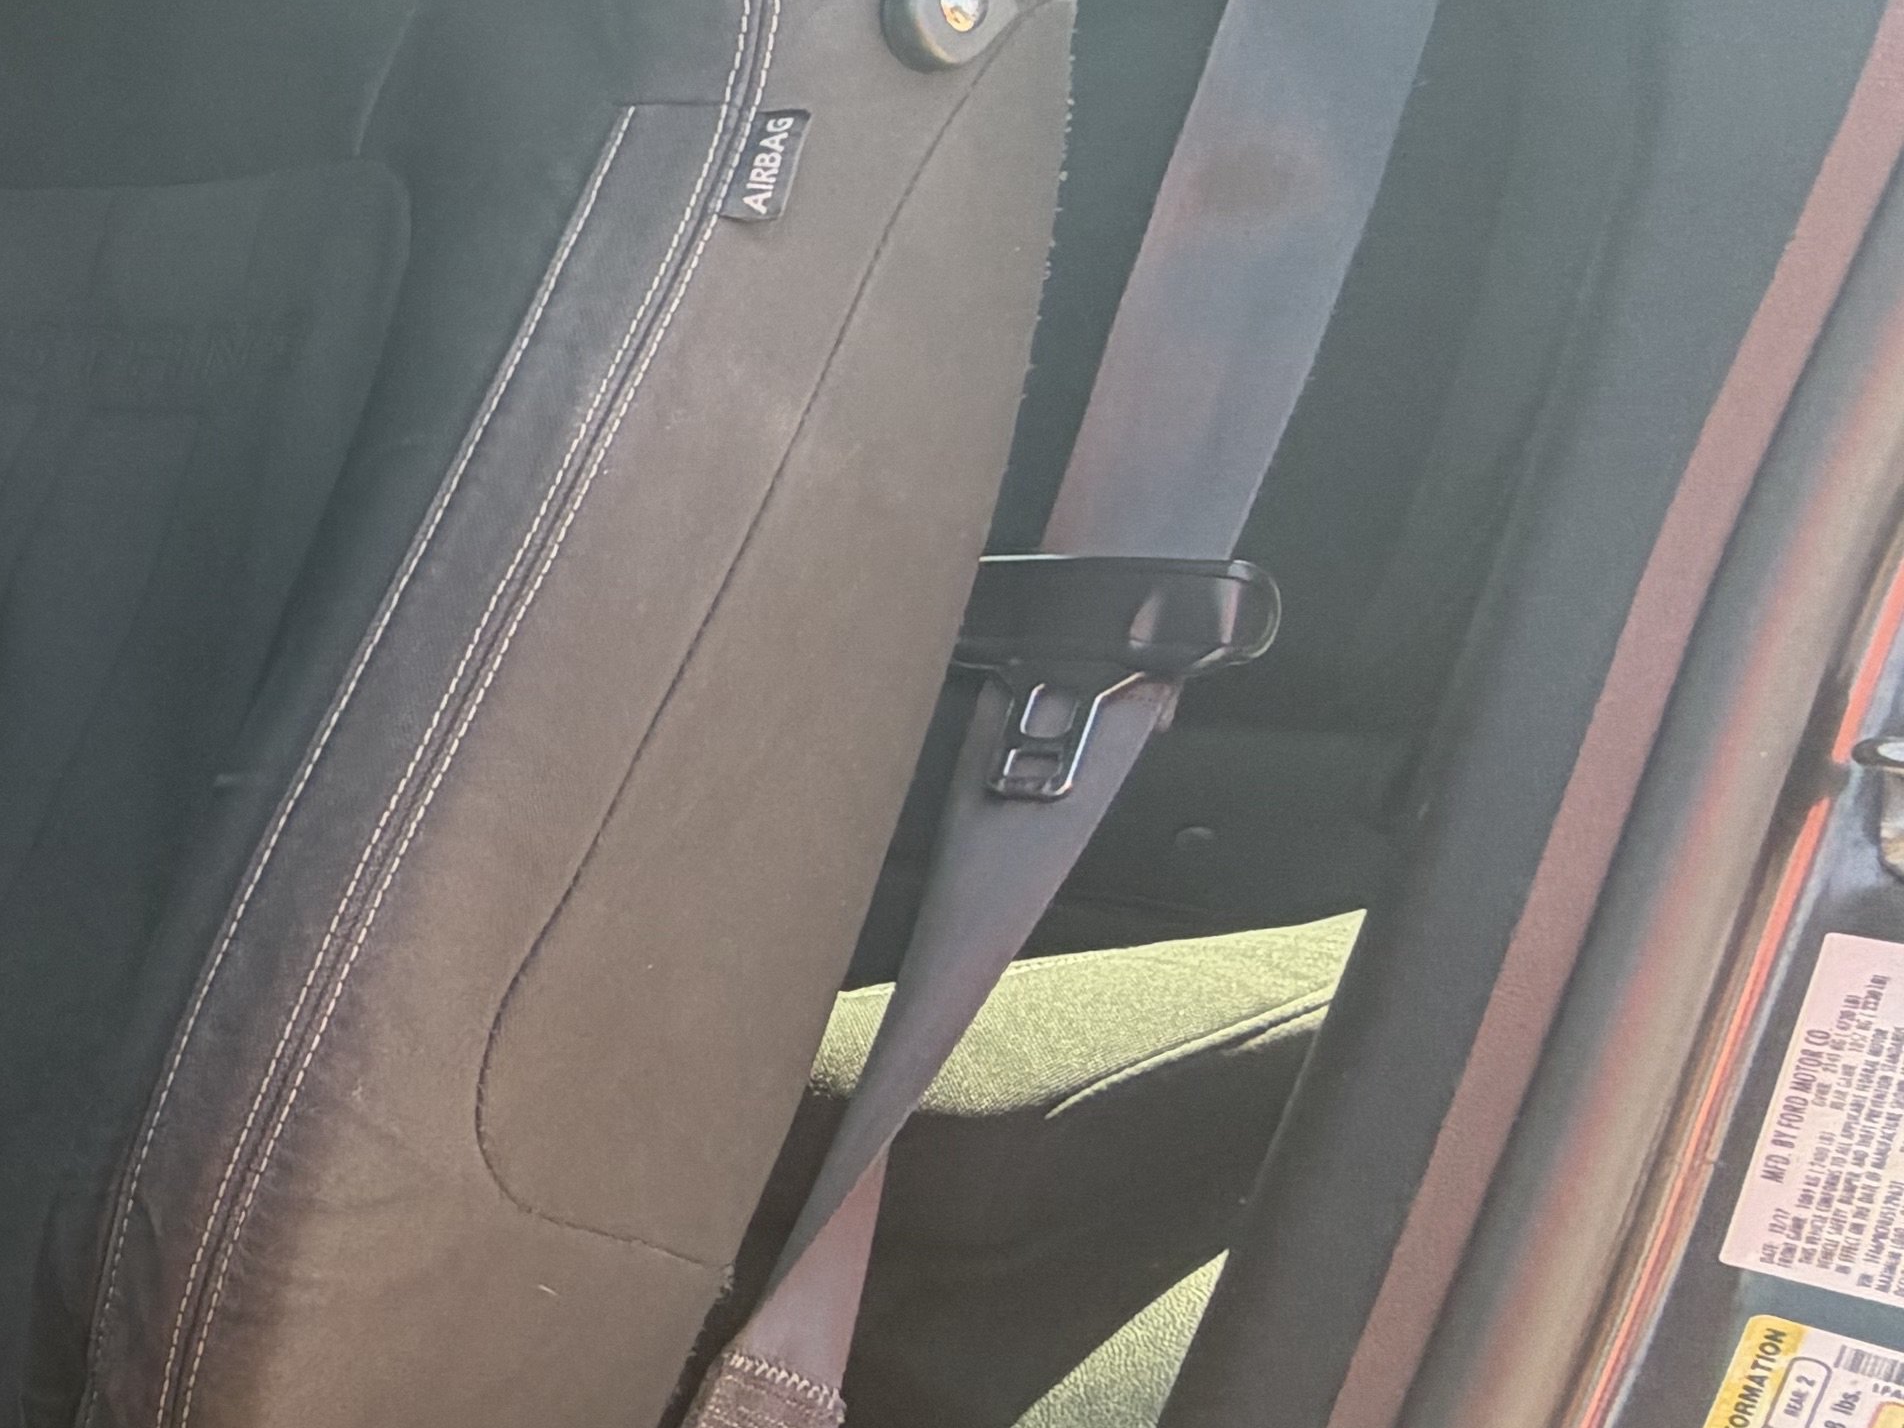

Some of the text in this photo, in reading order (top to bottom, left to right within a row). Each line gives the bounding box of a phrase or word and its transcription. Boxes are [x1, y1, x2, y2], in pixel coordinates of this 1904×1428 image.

[742, 117, 795, 215] AIRBAG
[1789, 1048, 1823, 1093] MOTOR
[1776, 1095, 1808, 1130] FORD
[1770, 1129, 1797, 1149] BY
[1795, 1374, 1816, 1387] 2
[1830, 1390, 1861, 1416] lbs.
